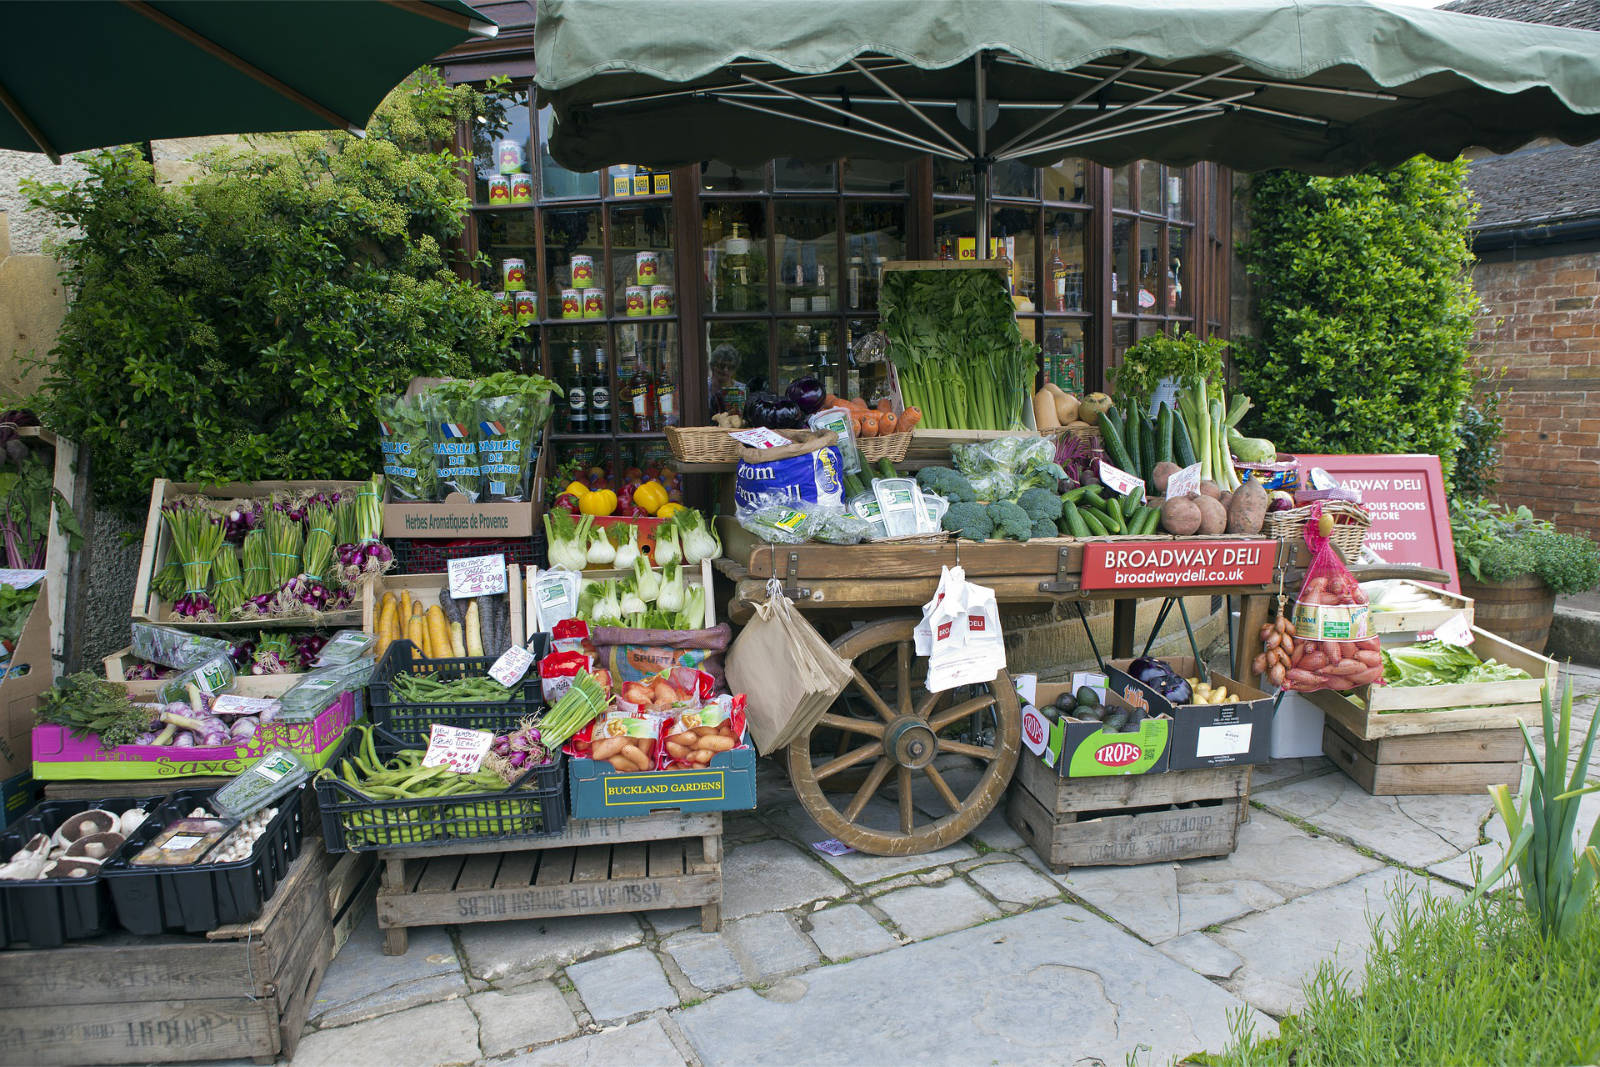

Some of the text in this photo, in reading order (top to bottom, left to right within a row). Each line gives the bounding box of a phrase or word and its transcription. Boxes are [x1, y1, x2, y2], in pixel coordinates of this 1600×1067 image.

[1341, 480, 1422, 490] ADWAY DELI
[1390, 502, 1426, 511] FLOORS
[405, 513, 509, 536] Herbes Aromatiques de Provence
[1364, 532, 1417, 541] OUS FOODS
[1369, 542, 1393, 551] WINE
[1105, 548, 1260, 569] BROADWAY DELI
[1115, 568, 1244, 584] broadwaydeli.co.uk
[634, 653, 676, 665] SPUNTA
[1024, 715, 1043, 744] TROPS
[1097, 744, 1140, 762] TROPS
[608, 781, 720, 795] BUCKLAND GARDENS
